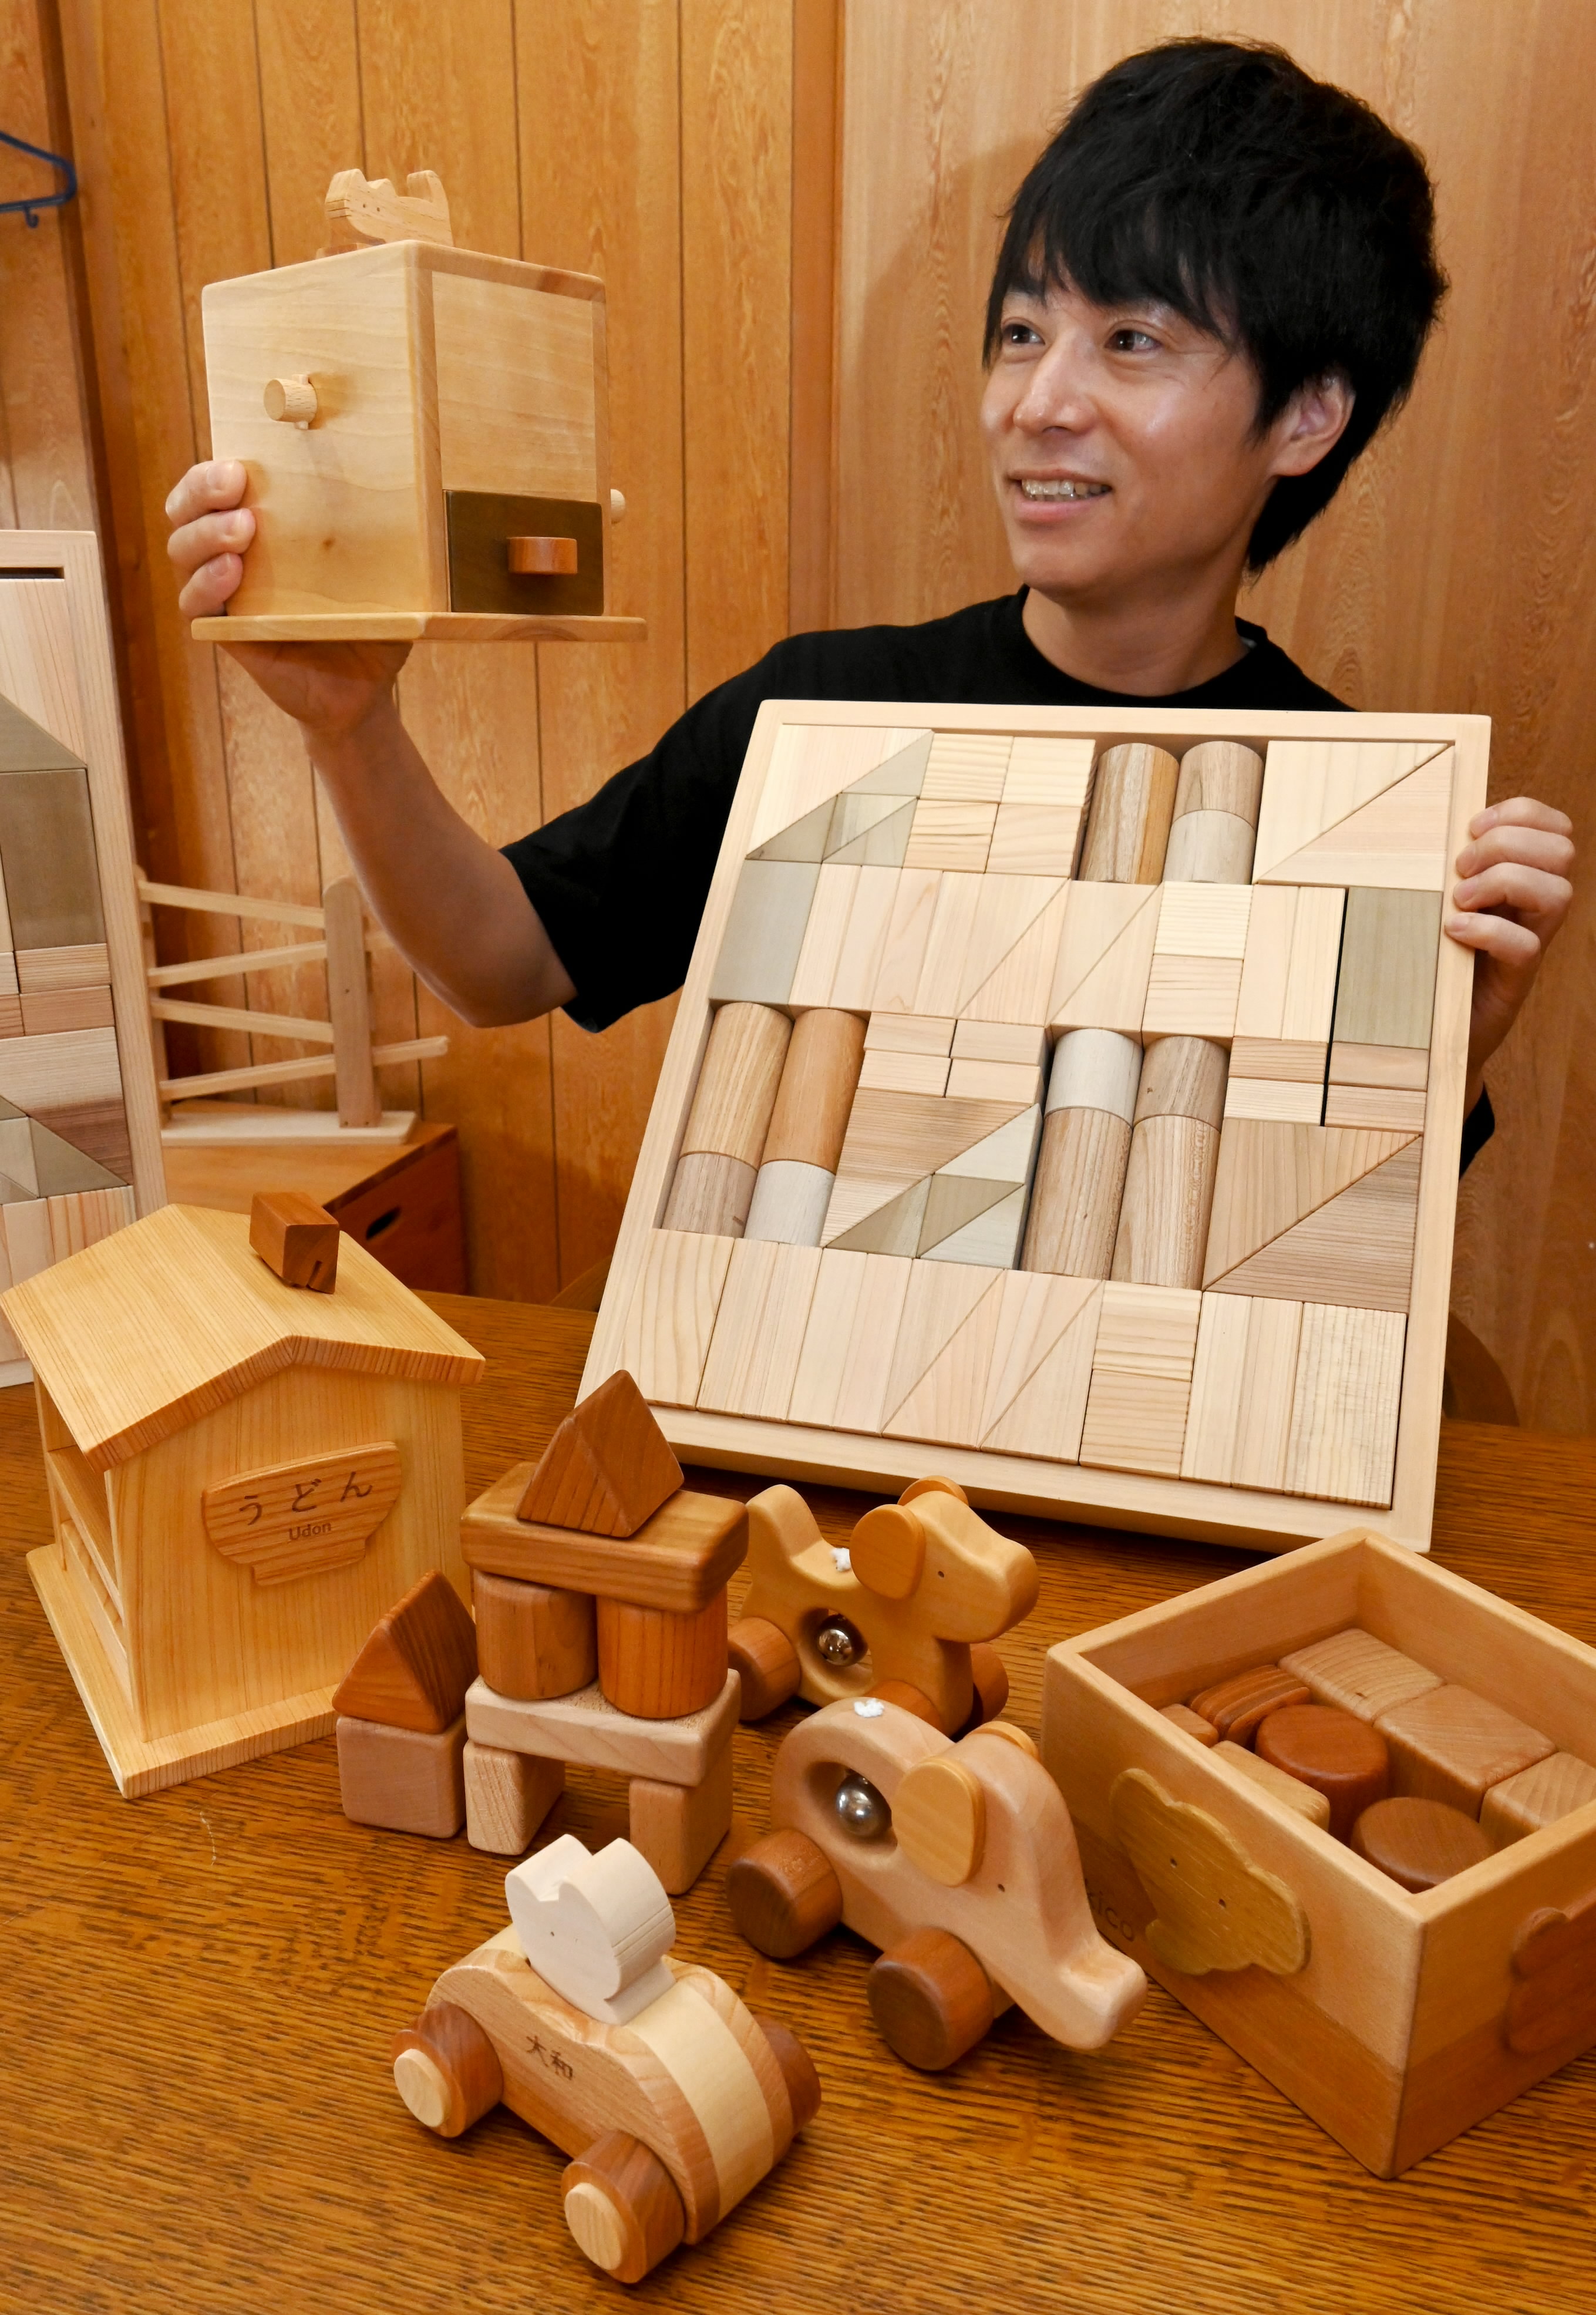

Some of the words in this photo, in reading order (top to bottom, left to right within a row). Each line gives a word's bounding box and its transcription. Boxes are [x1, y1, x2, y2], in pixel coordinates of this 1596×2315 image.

[239, 1471, 372, 1526] うどん
[288, 1522, 332, 1540] Udon
[526, 2035, 573, 2081] 大和
